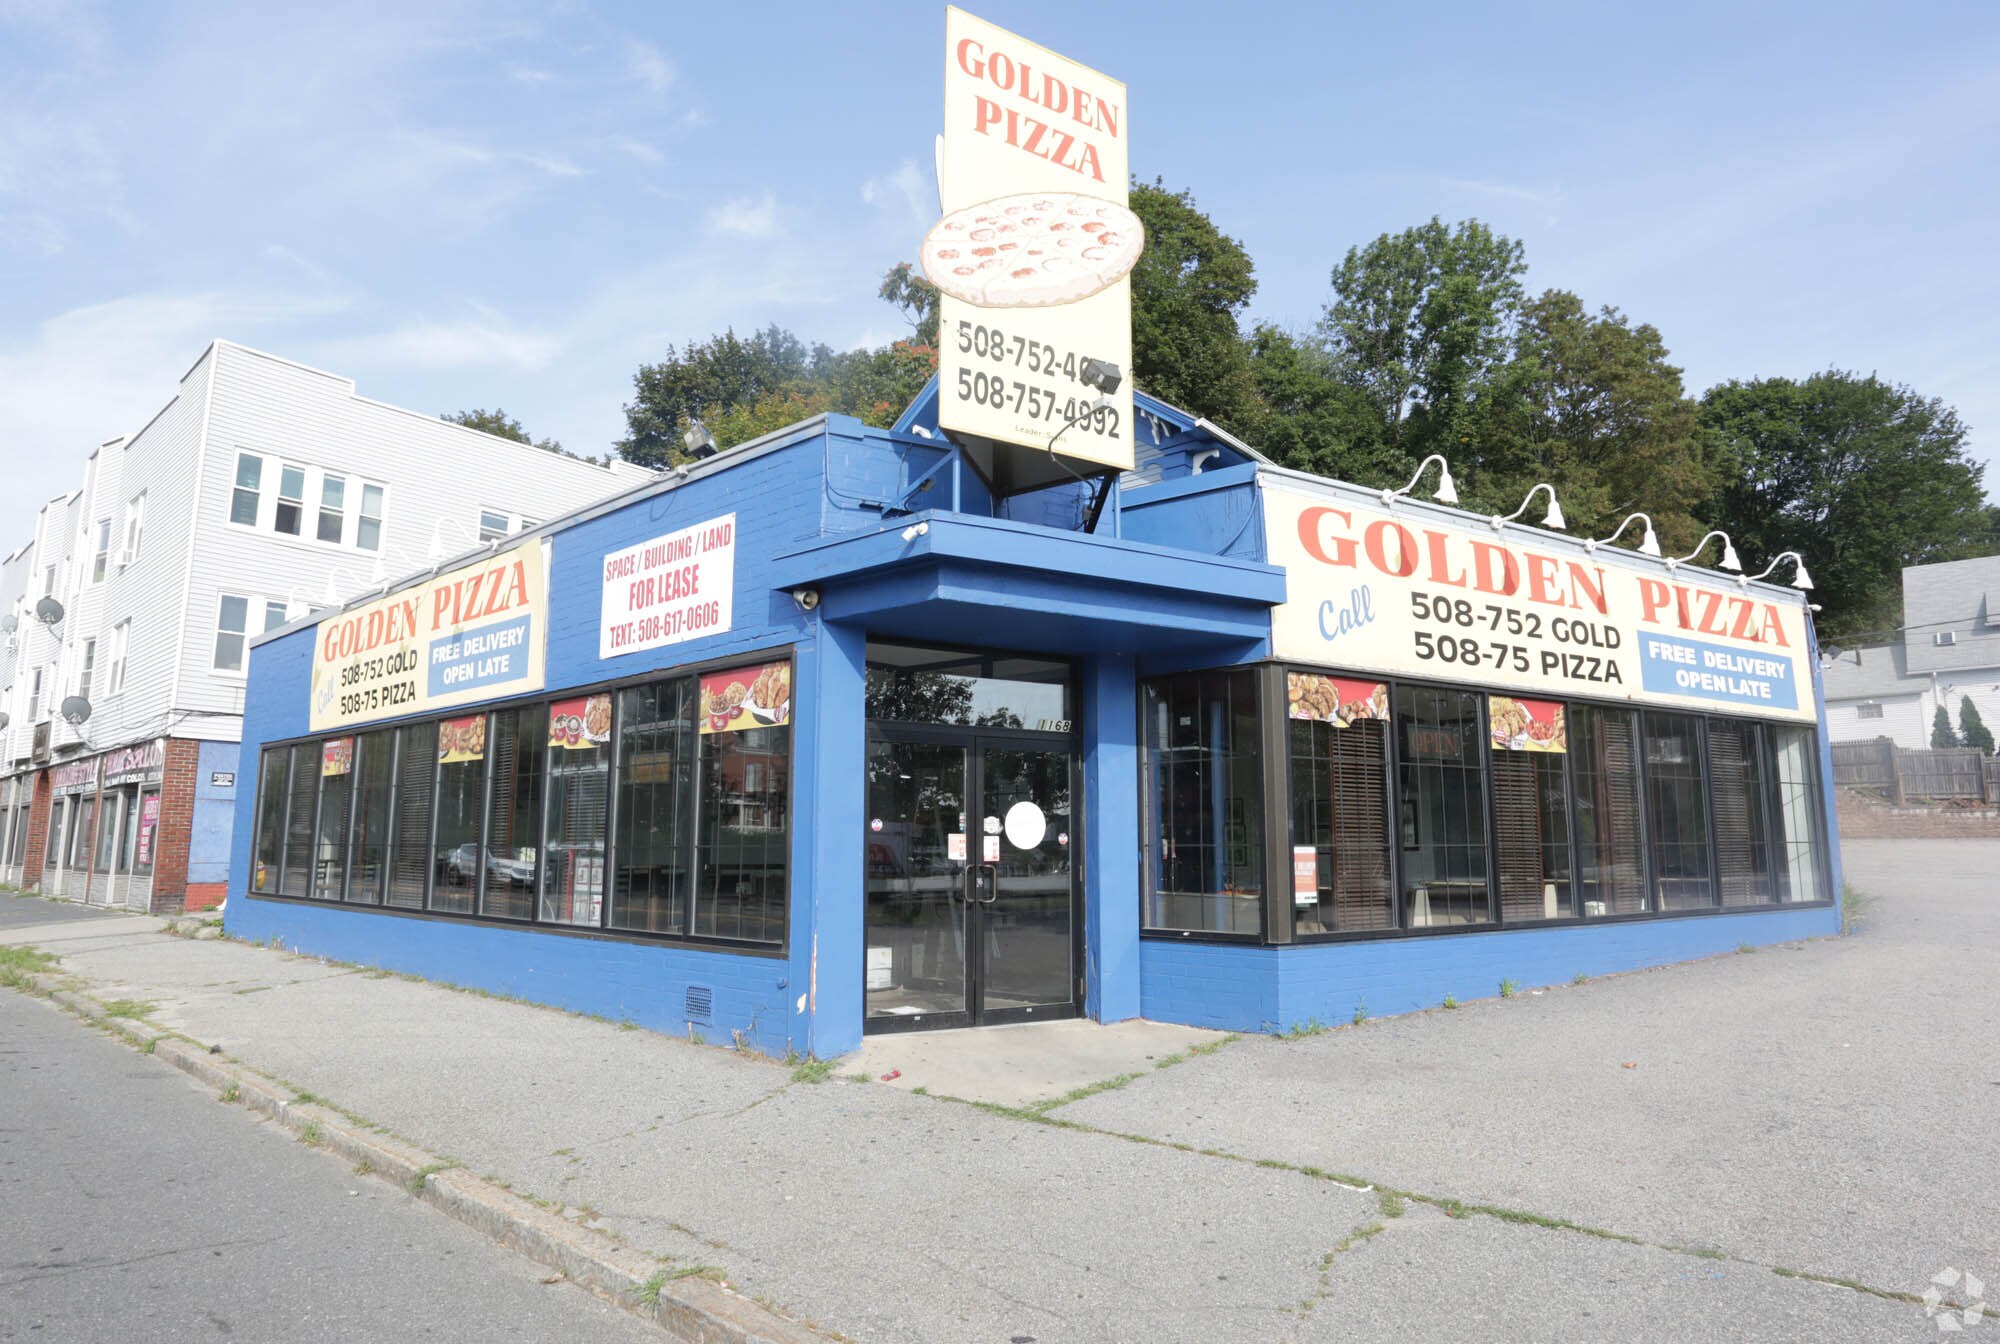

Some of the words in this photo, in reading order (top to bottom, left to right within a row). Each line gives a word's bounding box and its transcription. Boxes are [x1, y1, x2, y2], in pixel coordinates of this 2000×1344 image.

[957, 38, 1119, 138] GOLDEN
[974, 95, 1106, 184] PIZZA
[958, 367, 1120, 439] 508-757-4992
[606, 554, 636, 582] SPACE
[644, 535, 692, 570] BUILDING
[703, 523, 732, 553] LAND
[1297, 506, 1608, 615] GOLDEN
[1636, 577, 1791, 648] PIZZA
[324, 595, 420, 663] GOLDEN
[431, 559, 529, 631] PIZZA
[629, 577, 655, 611] FOR
[658, 563, 700, 604] LEASE
[1318, 584, 1376, 641] Call
[432, 642, 460, 665] FREE
[464, 626, 526, 657] DELIVERY
[610, 622, 636, 649] TEXT:
[638, 600, 719, 643] 508-617-0606
[1411, 591, 1543, 639] 508-752
[1551, 617, 1621, 650] GOLD
[341, 660, 384, 687] 508-752
[387, 649, 418, 675] GOLD
[443, 662, 474, 685] OPEN
[478, 655, 510, 678] LATE
[1414, 631, 1531, 673] 508-75
[1541, 650, 1623, 684] PIZZA
[1648, 640, 1697, 665] FREE
[1703, 651, 1786, 680] DELIVERY
[340, 689, 378, 716] 508-75
[381, 681, 416, 706] PIZZA
[1675, 669, 1727, 692] OPEN
[1728, 677, 1772, 699] LATE
[1040, 719, 1070, 731] 1168
